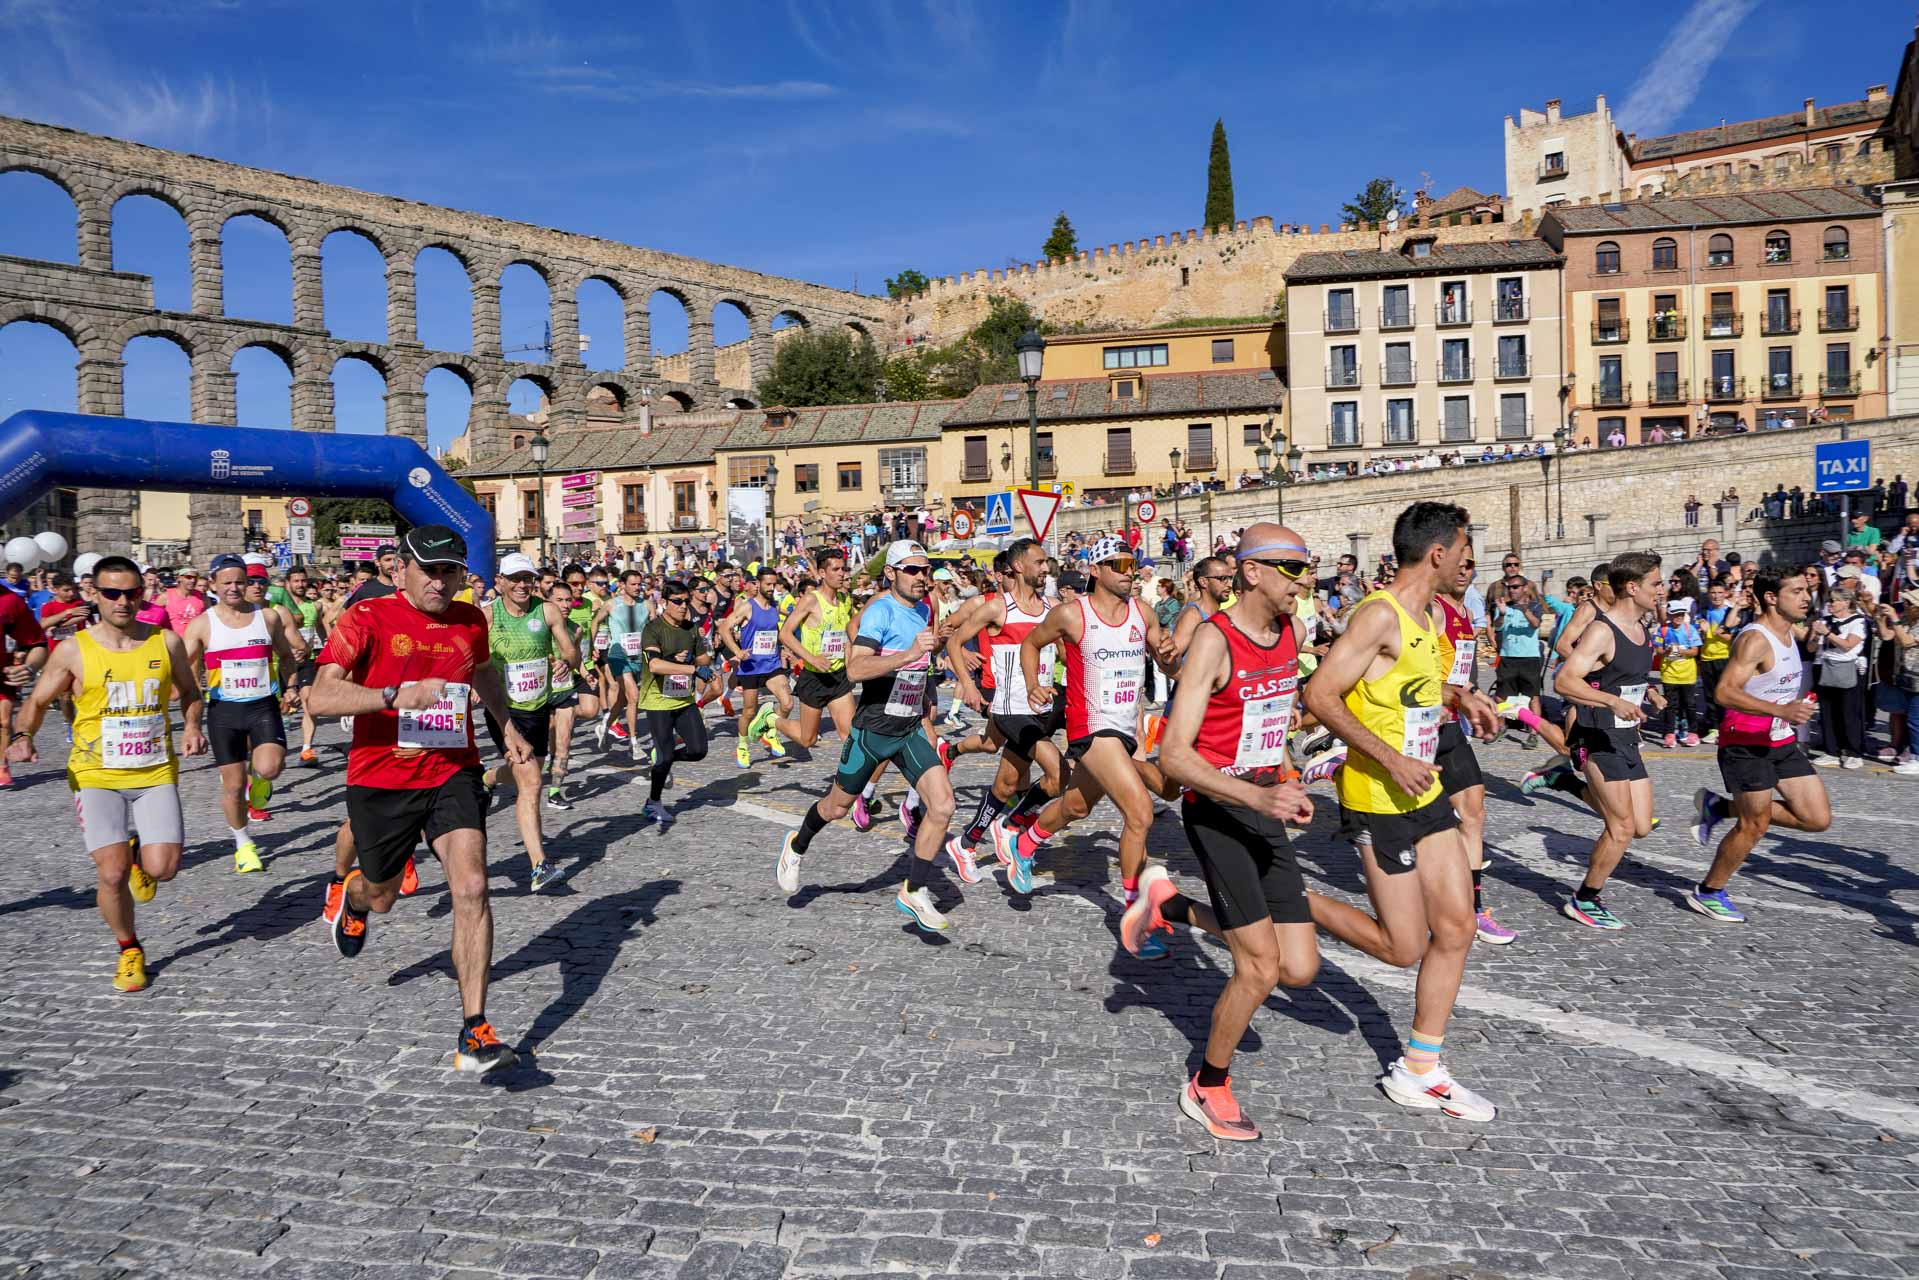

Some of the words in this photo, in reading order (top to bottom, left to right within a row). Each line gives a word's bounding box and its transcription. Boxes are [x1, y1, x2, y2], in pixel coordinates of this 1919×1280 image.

[1818, 457, 1867, 475] TAXI
[1140, 506, 1152, 517] 50
[234, 677, 258, 689] 1470
[516, 678, 539, 693] 1245
[1114, 689, 1135, 705] 646
[136, 703, 162, 714] TEAM
[416, 713, 454, 731] 1295
[122, 730, 151, 740] Hector
[1260, 729, 1284, 751] 702
[117, 740, 152, 756] 1283
